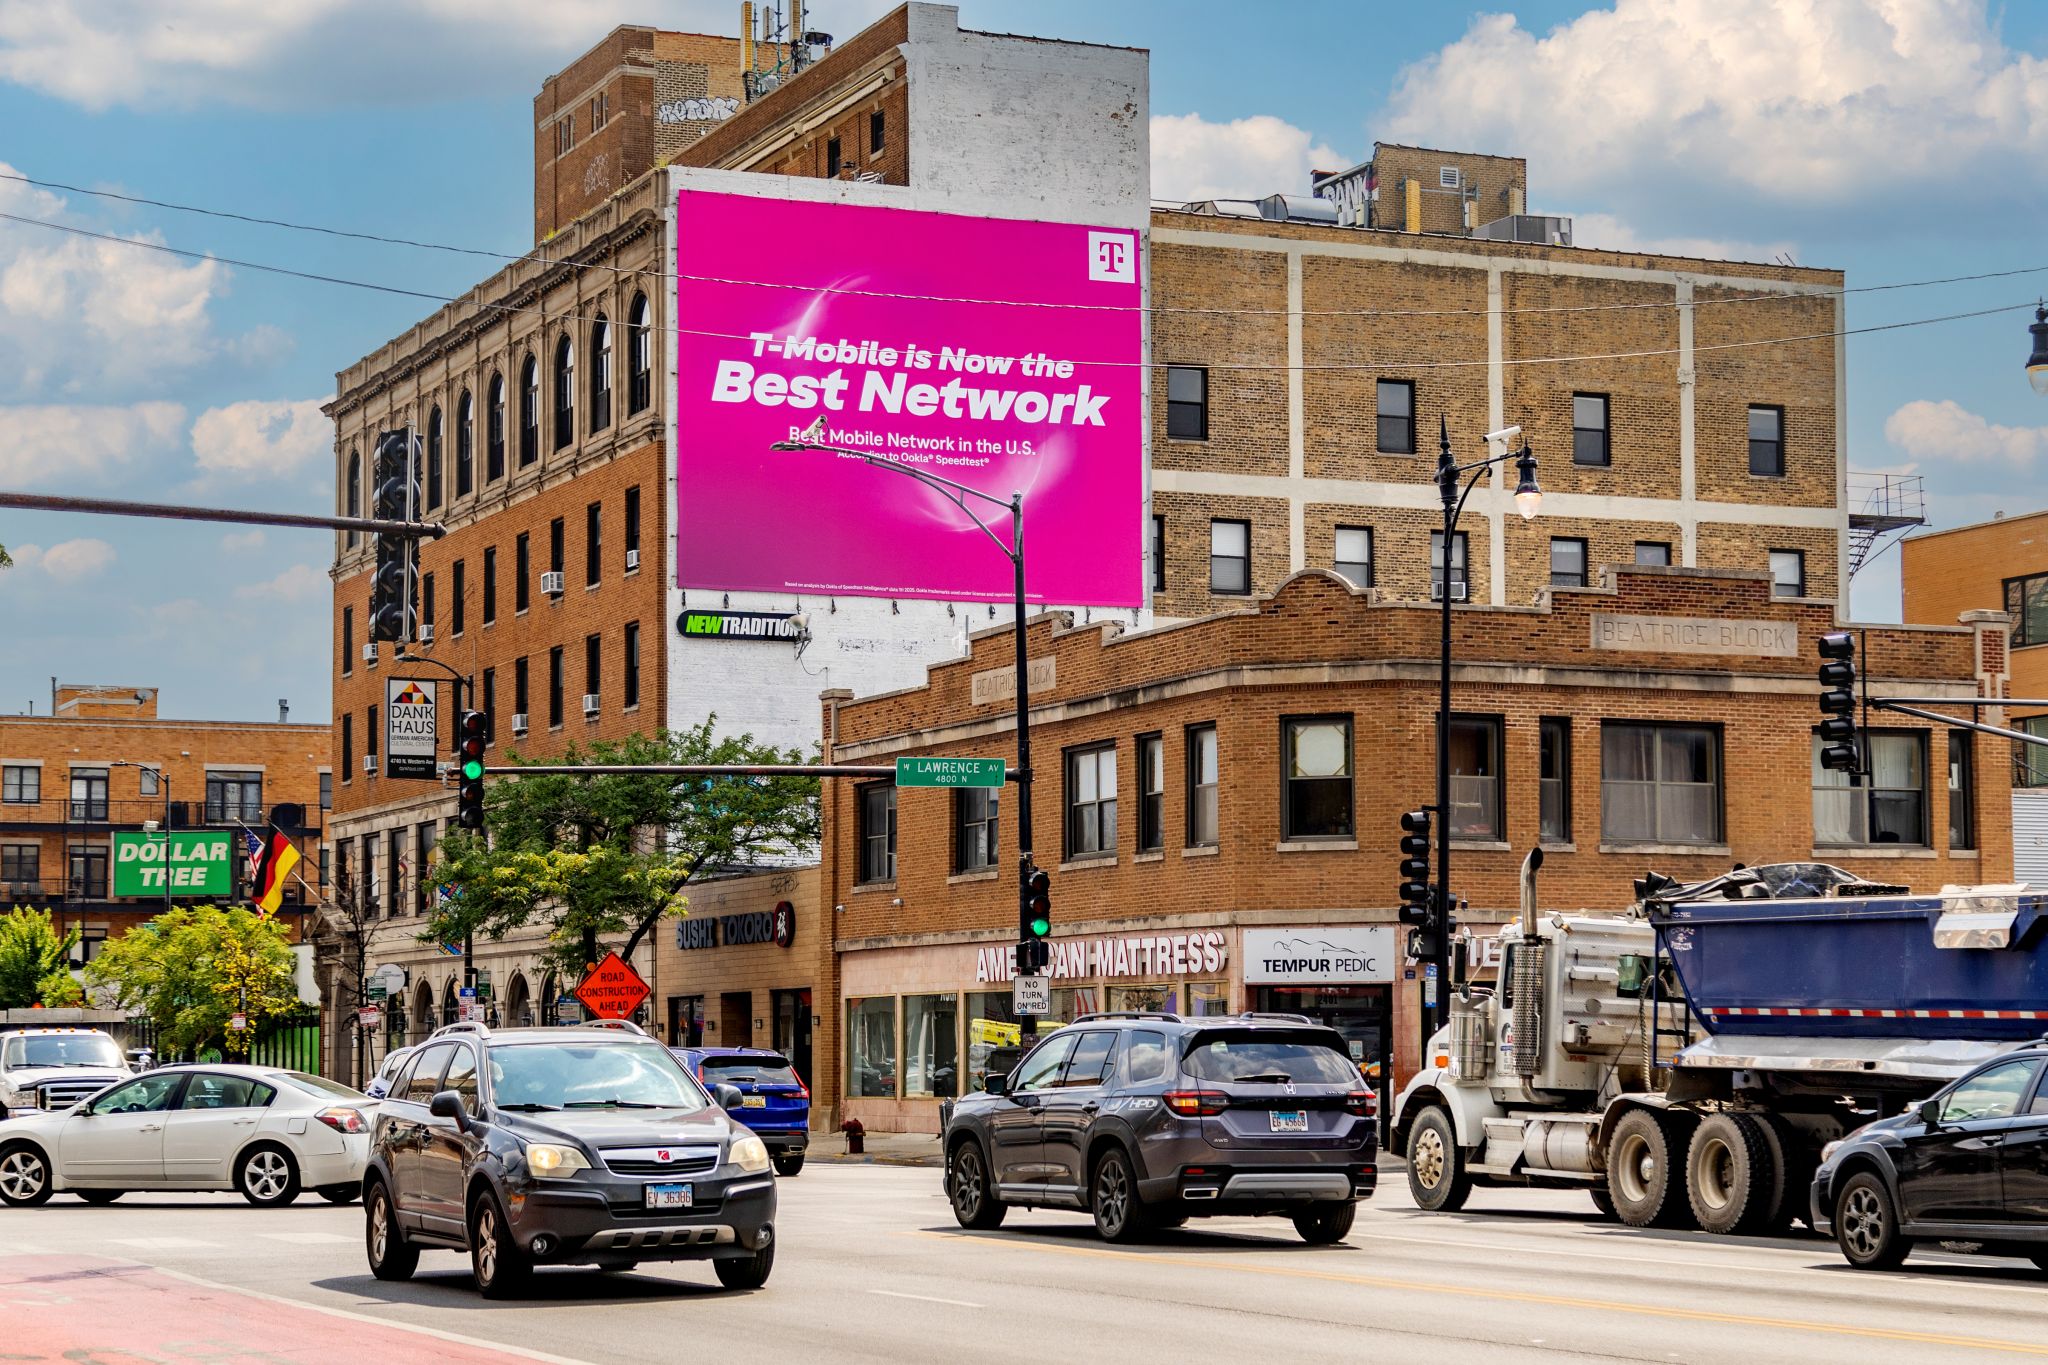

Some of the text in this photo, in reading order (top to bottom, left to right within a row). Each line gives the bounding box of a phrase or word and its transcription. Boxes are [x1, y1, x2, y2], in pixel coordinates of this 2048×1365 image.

[750, 332, 1074, 379] T-Mobile is Now the
[711, 360, 1111, 426] Best Network
[829, 428, 883, 447] Mobile
[887, 431, 955, 451] Network
[959, 437, 971, 452] in
[976, 439, 1001, 454] the
[1005, 440, 1036, 456] U.S.
[890, 451, 899, 461] to
[1602, 621, 1787, 649] BEATRICE BLOCK
[1028, 662, 1052, 686] LOCK
[391, 705, 434, 720] DANK
[391, 720, 434, 734] HAUS
[903, 763, 910, 771] W
[917, 762, 980, 774] LAWRENCE
[935, 775, 967, 783] 4800 N
[118, 842, 228, 862] DOLLAR
[139, 867, 208, 887] TREE
[676, 917, 714, 950] SUSHI
[720, 912, 774, 946] TOKORO
[976, 932, 1225, 983] AMECAN MATTRESS
[1263, 958, 1376, 973] TEMPUR PEDIC
[600, 972, 625, 983] ROAD
[580, 986, 644, 998] CONSTRUCTION
[1024, 981, 1038, 989] NO
[1021, 991, 1043, 999] TURN
[599, 1001, 629, 1011] AHEAD
[1017, 1002, 1047, 1010] ON RED
[647, 1191, 659, 1205] EV
